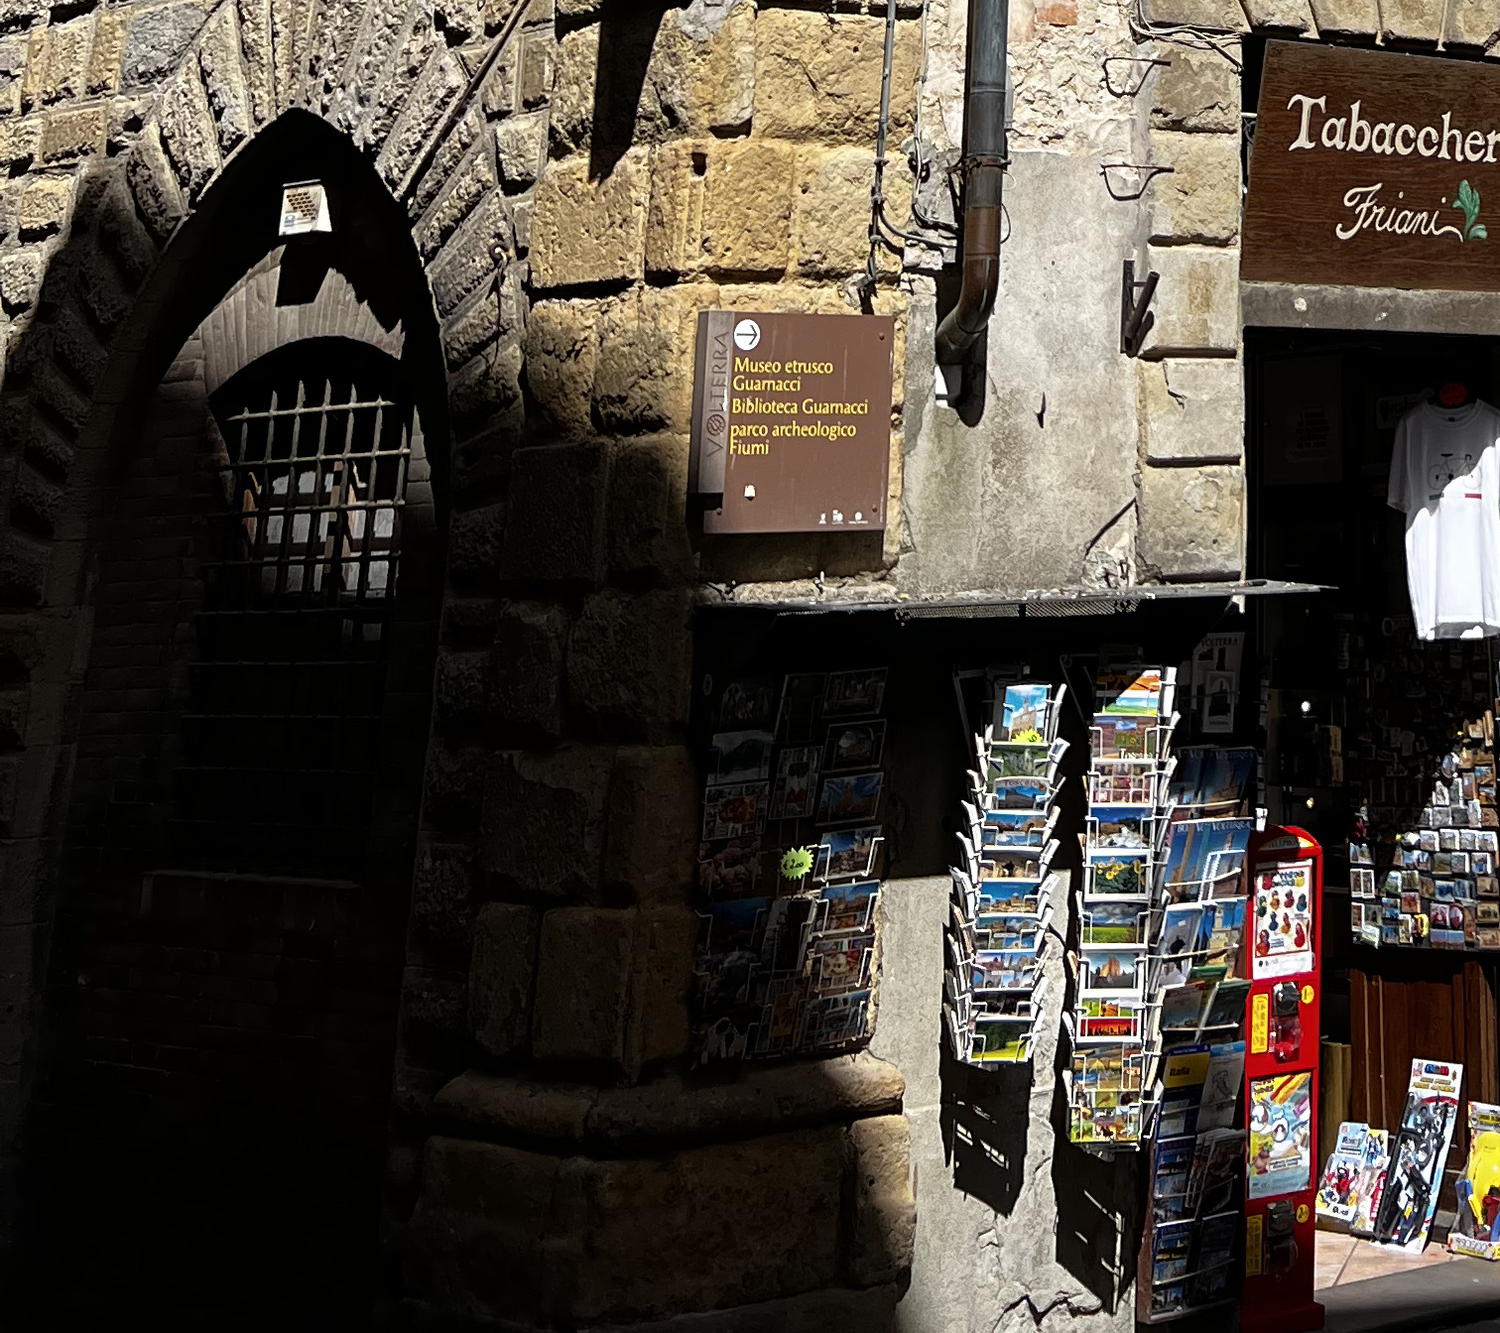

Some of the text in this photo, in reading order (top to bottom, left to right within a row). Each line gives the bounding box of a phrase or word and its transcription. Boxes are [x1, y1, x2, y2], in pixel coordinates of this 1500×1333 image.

[1335, 182, 1464, 243] Friani
[734, 357, 833, 374] Museo etrusco
[733, 375, 801, 391] Guarnacci
[732, 398, 868, 414] Biblioteca Guarnacci
[730, 420, 857, 441] parco archeologico
[729, 439, 769, 455] Fiumi
[1170, 1066, 1191, 1076] Italia
